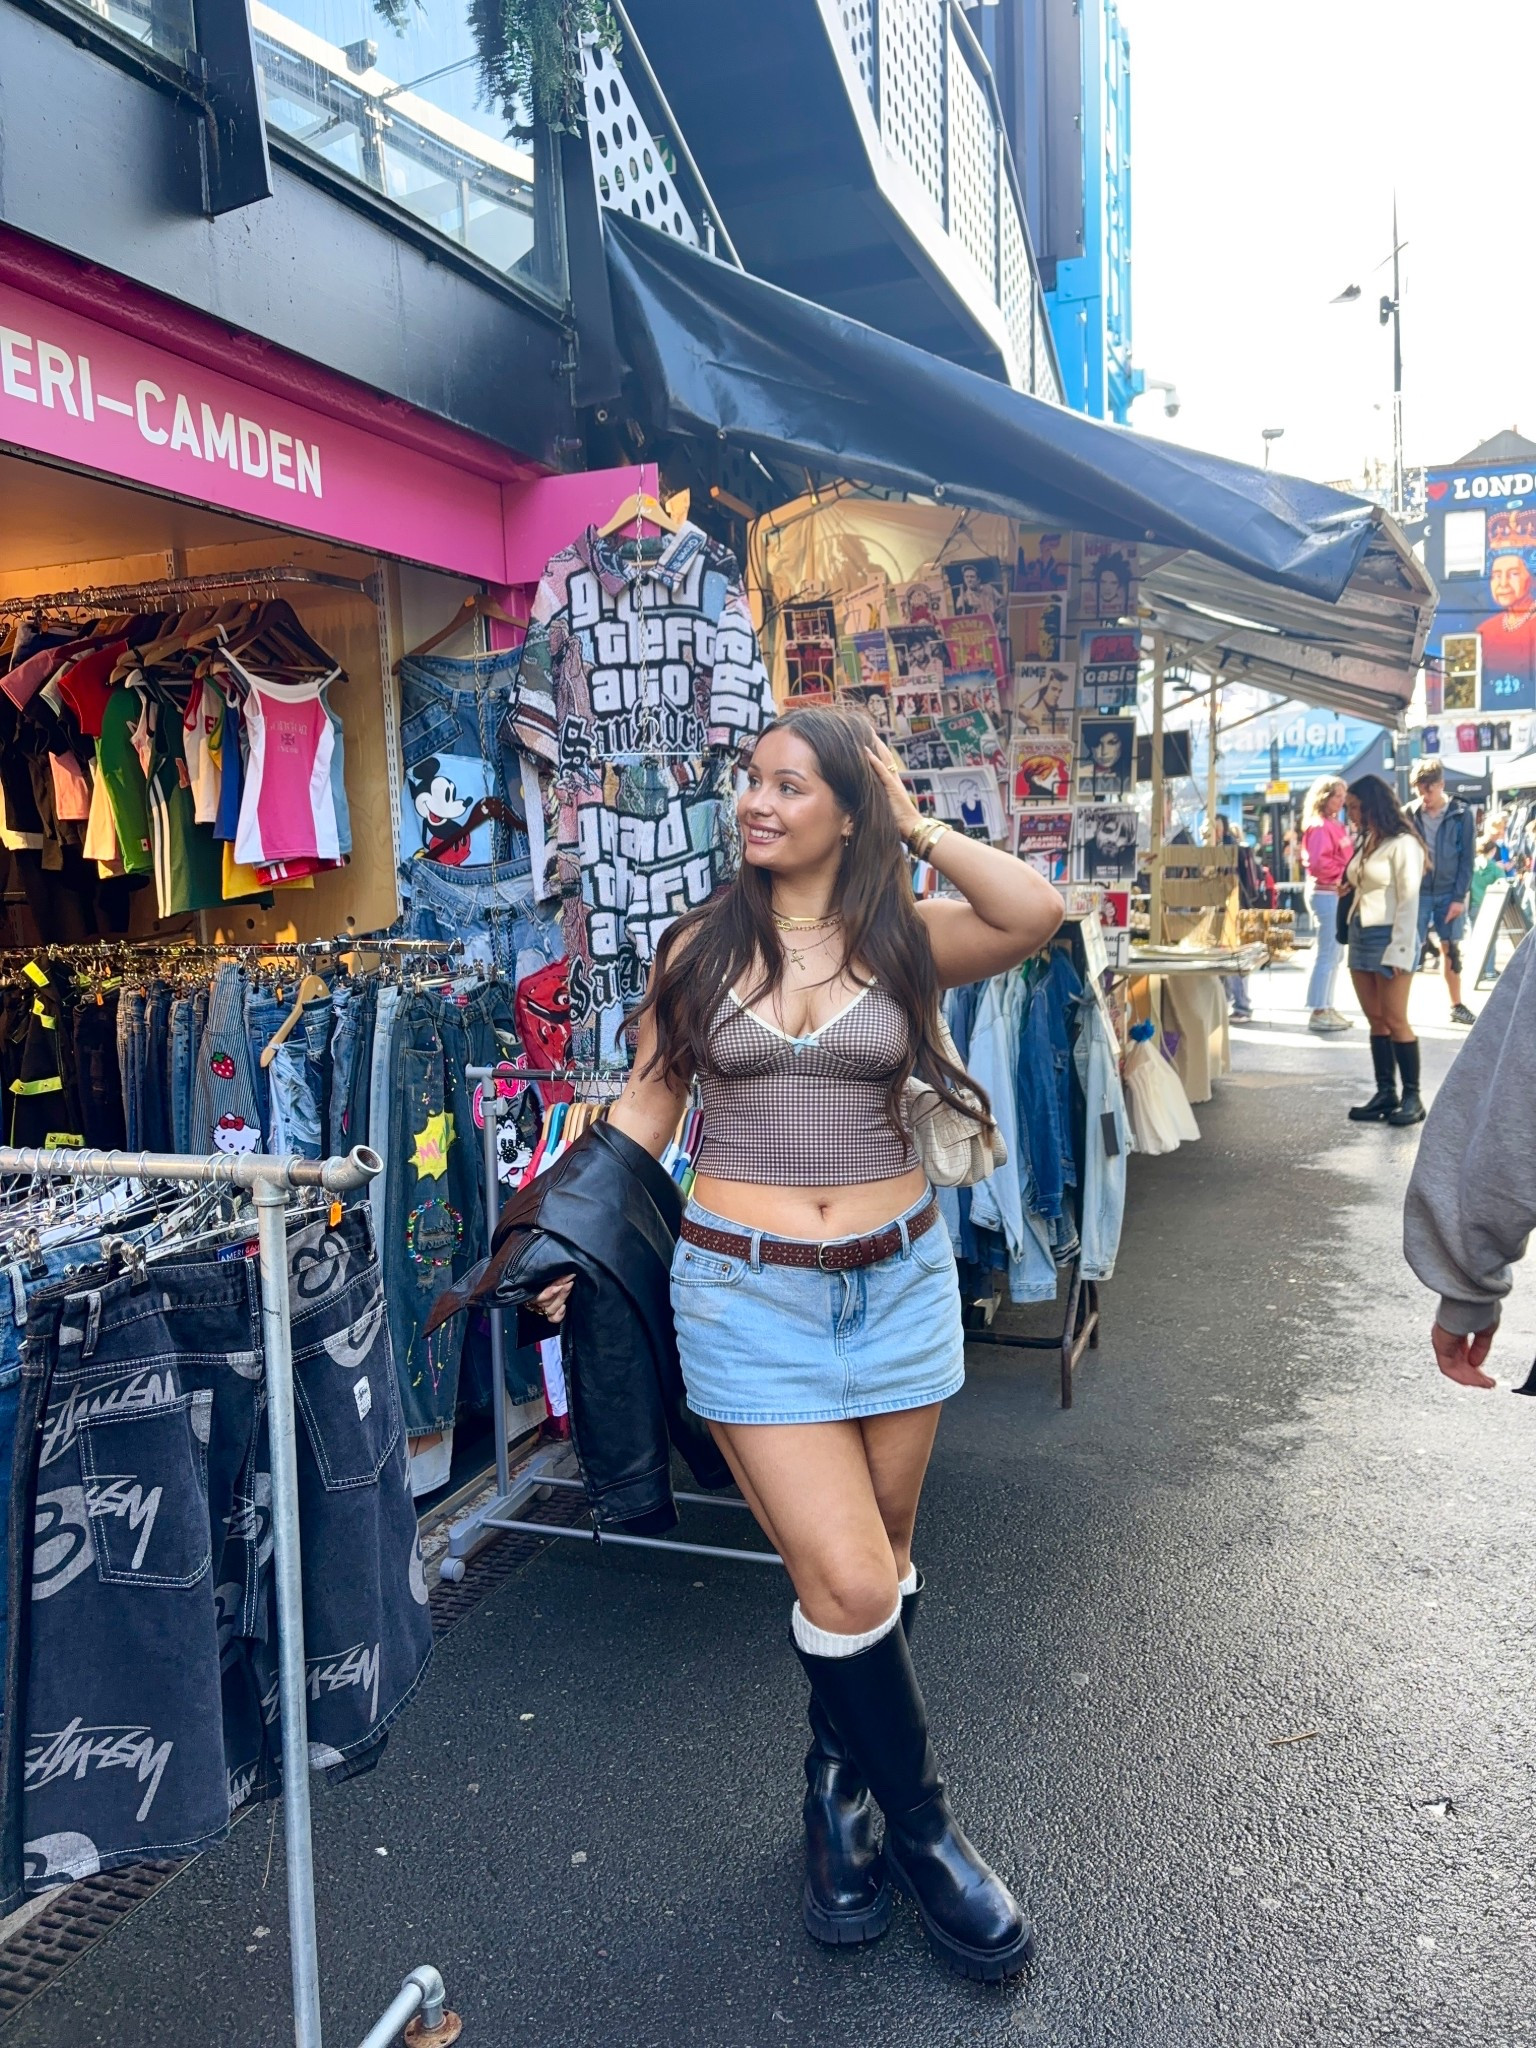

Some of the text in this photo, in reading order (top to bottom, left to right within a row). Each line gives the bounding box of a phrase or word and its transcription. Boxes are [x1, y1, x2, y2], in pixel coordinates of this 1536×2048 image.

[1453, 472, 1536, 500] LOND
[1085, 667, 1136, 684] oasis
[1080, 776, 1130, 792] AMY
